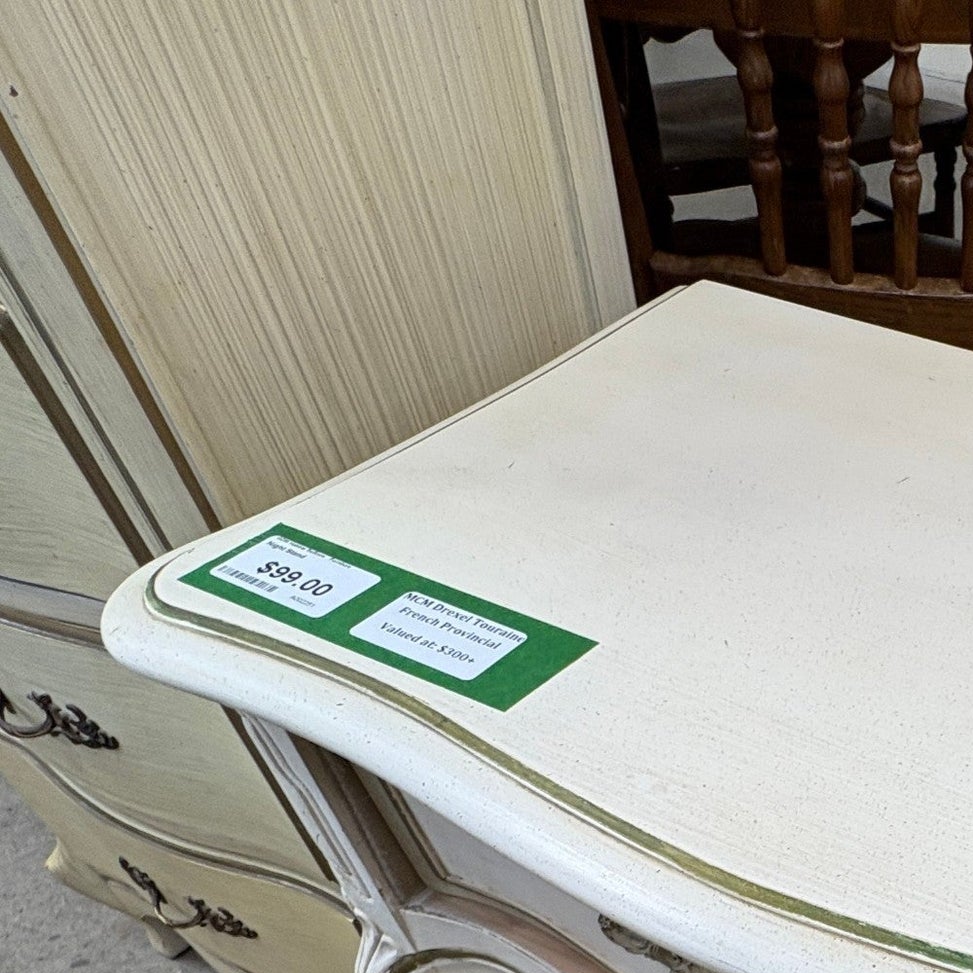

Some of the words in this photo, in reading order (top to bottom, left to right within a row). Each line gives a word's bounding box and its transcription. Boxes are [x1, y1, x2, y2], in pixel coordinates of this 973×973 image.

[266, 541, 286, 553] Night
[286, 547, 307, 559] Stand
[257, 561, 334, 596] $99.00
[403, 592, 433, 609] MCM
[432, 602, 474, 623] Drexel
[379, 622, 420, 643] Valued
[419, 639, 438, 651] at:
[436, 643, 475, 664] $300+
[398, 606, 439, 627] French
[439, 621, 502, 650] Provincial
